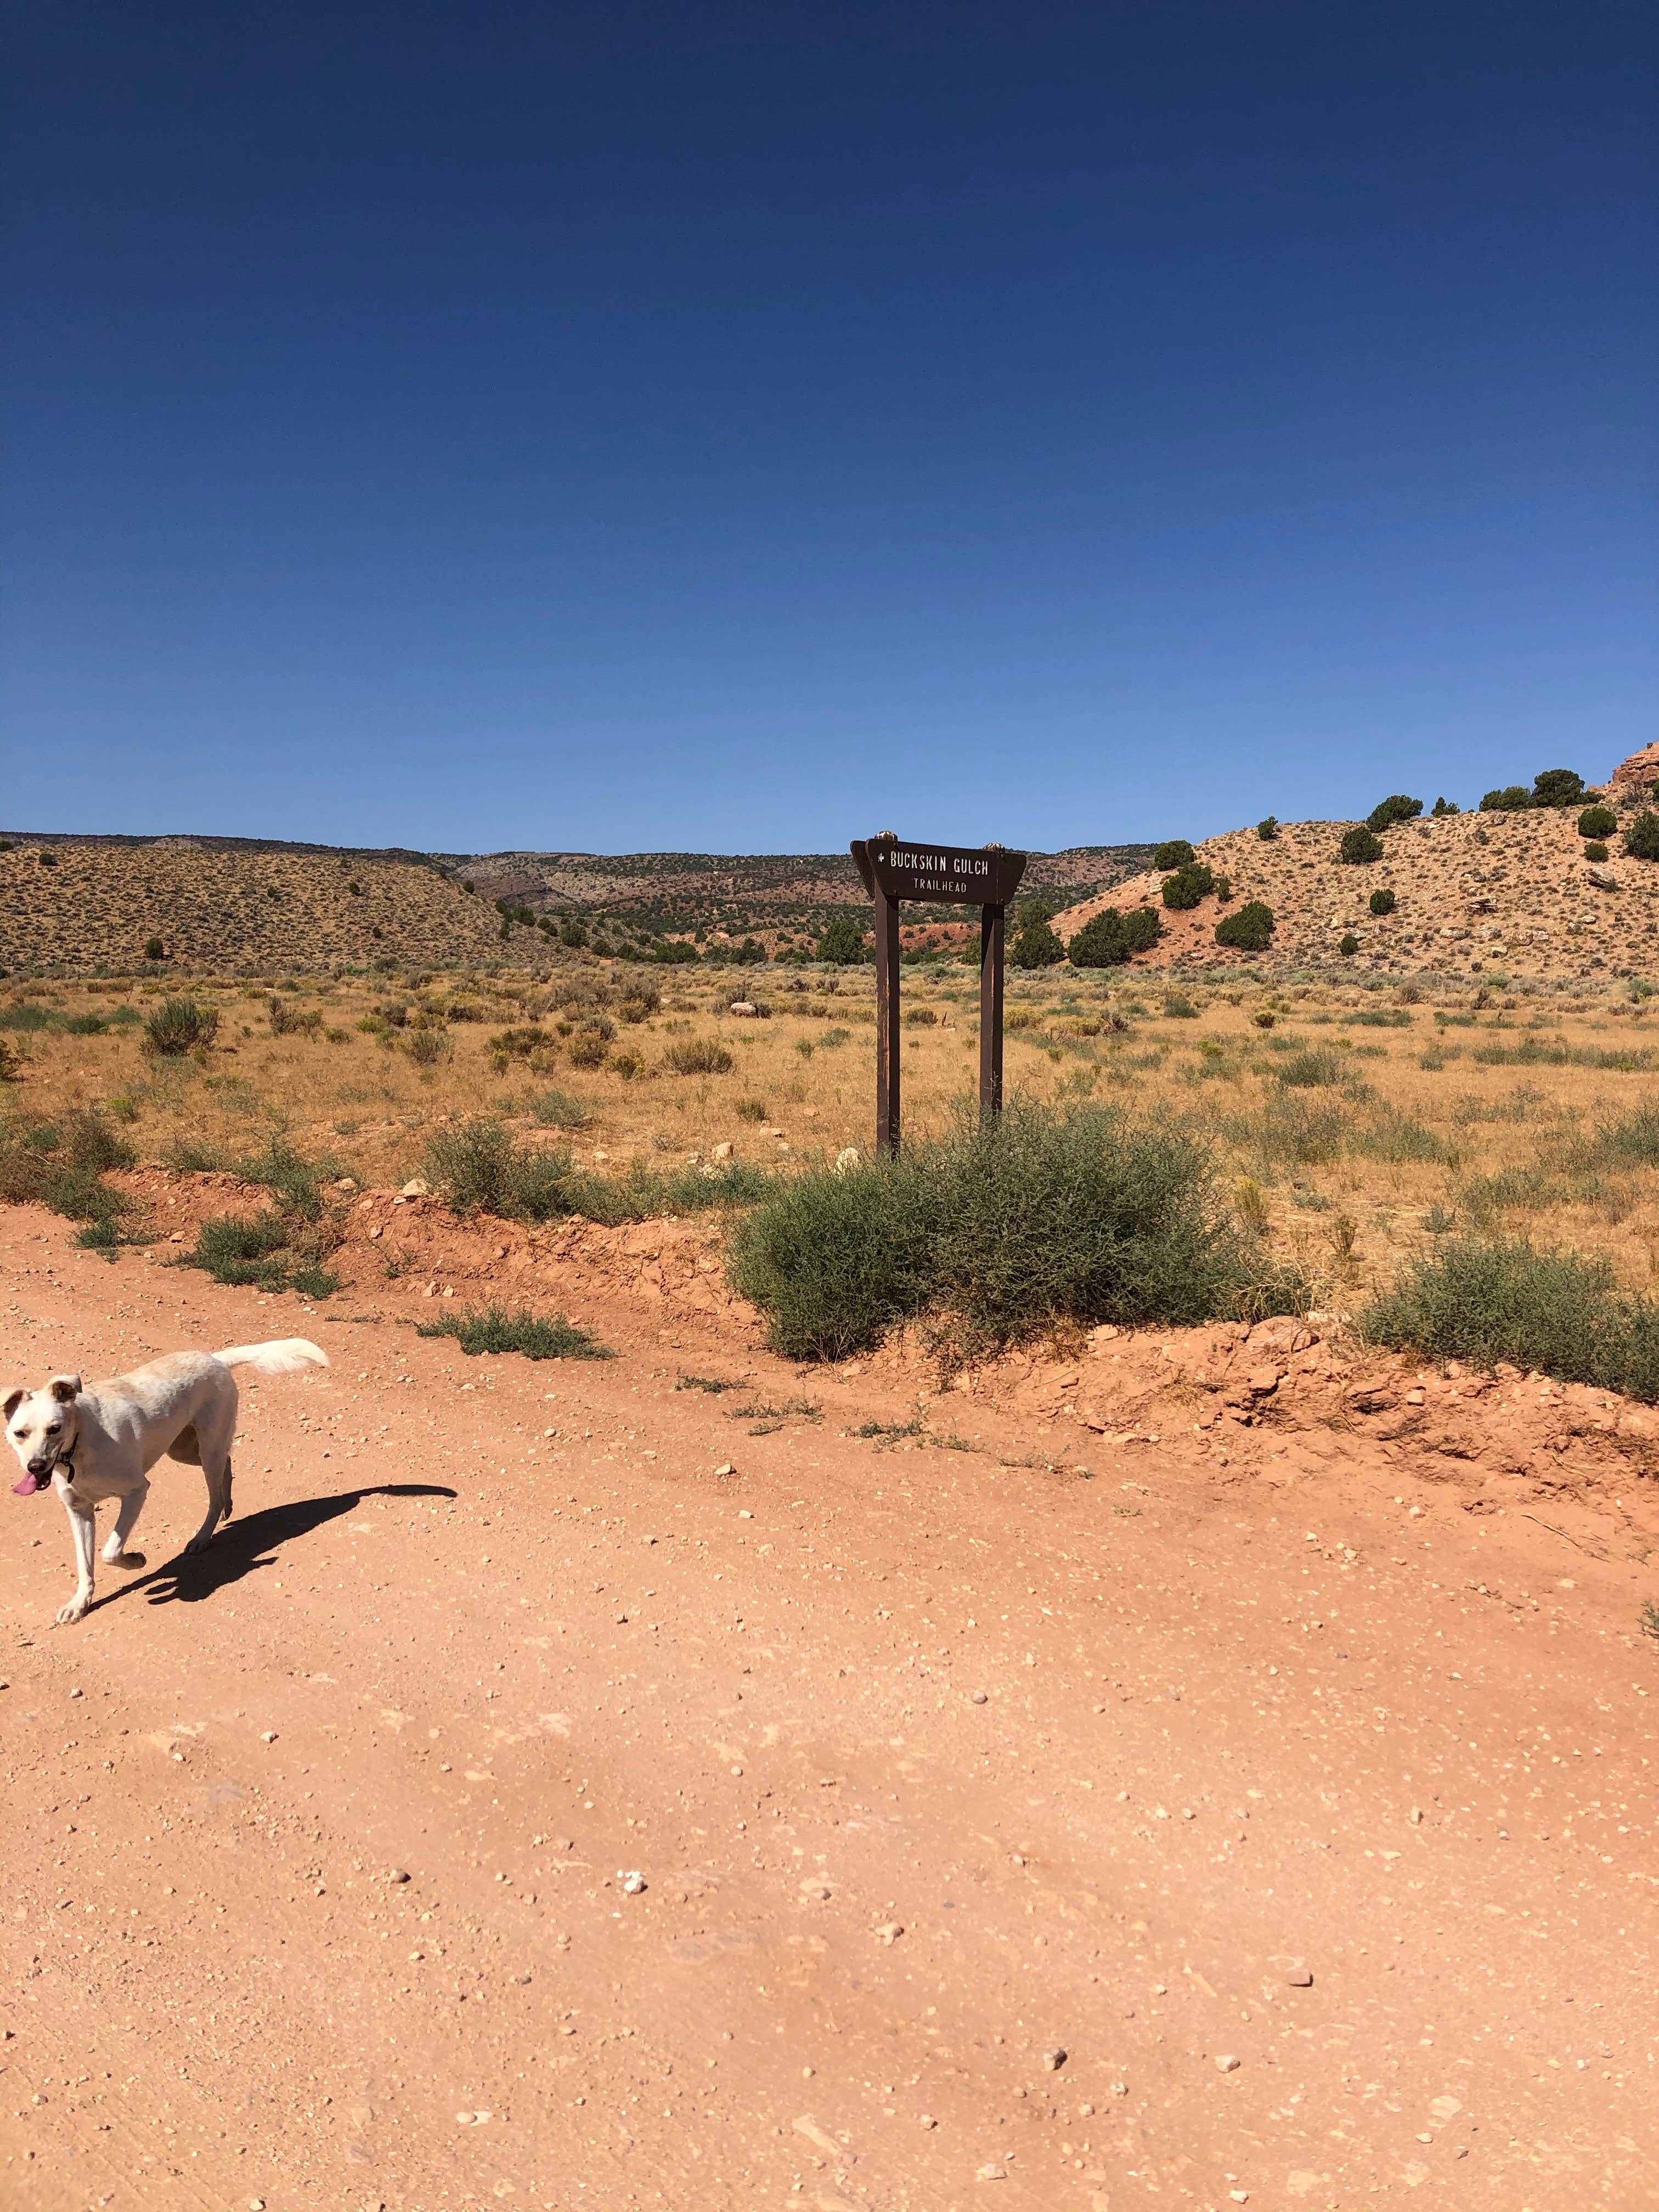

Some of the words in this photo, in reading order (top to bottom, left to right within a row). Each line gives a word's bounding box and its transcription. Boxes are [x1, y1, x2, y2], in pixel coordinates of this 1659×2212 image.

[890, 851, 946, 872] BUCKSKIN
[953, 857, 988, 875] GULCH
[913, 878, 967, 893] TRAILHEAD
